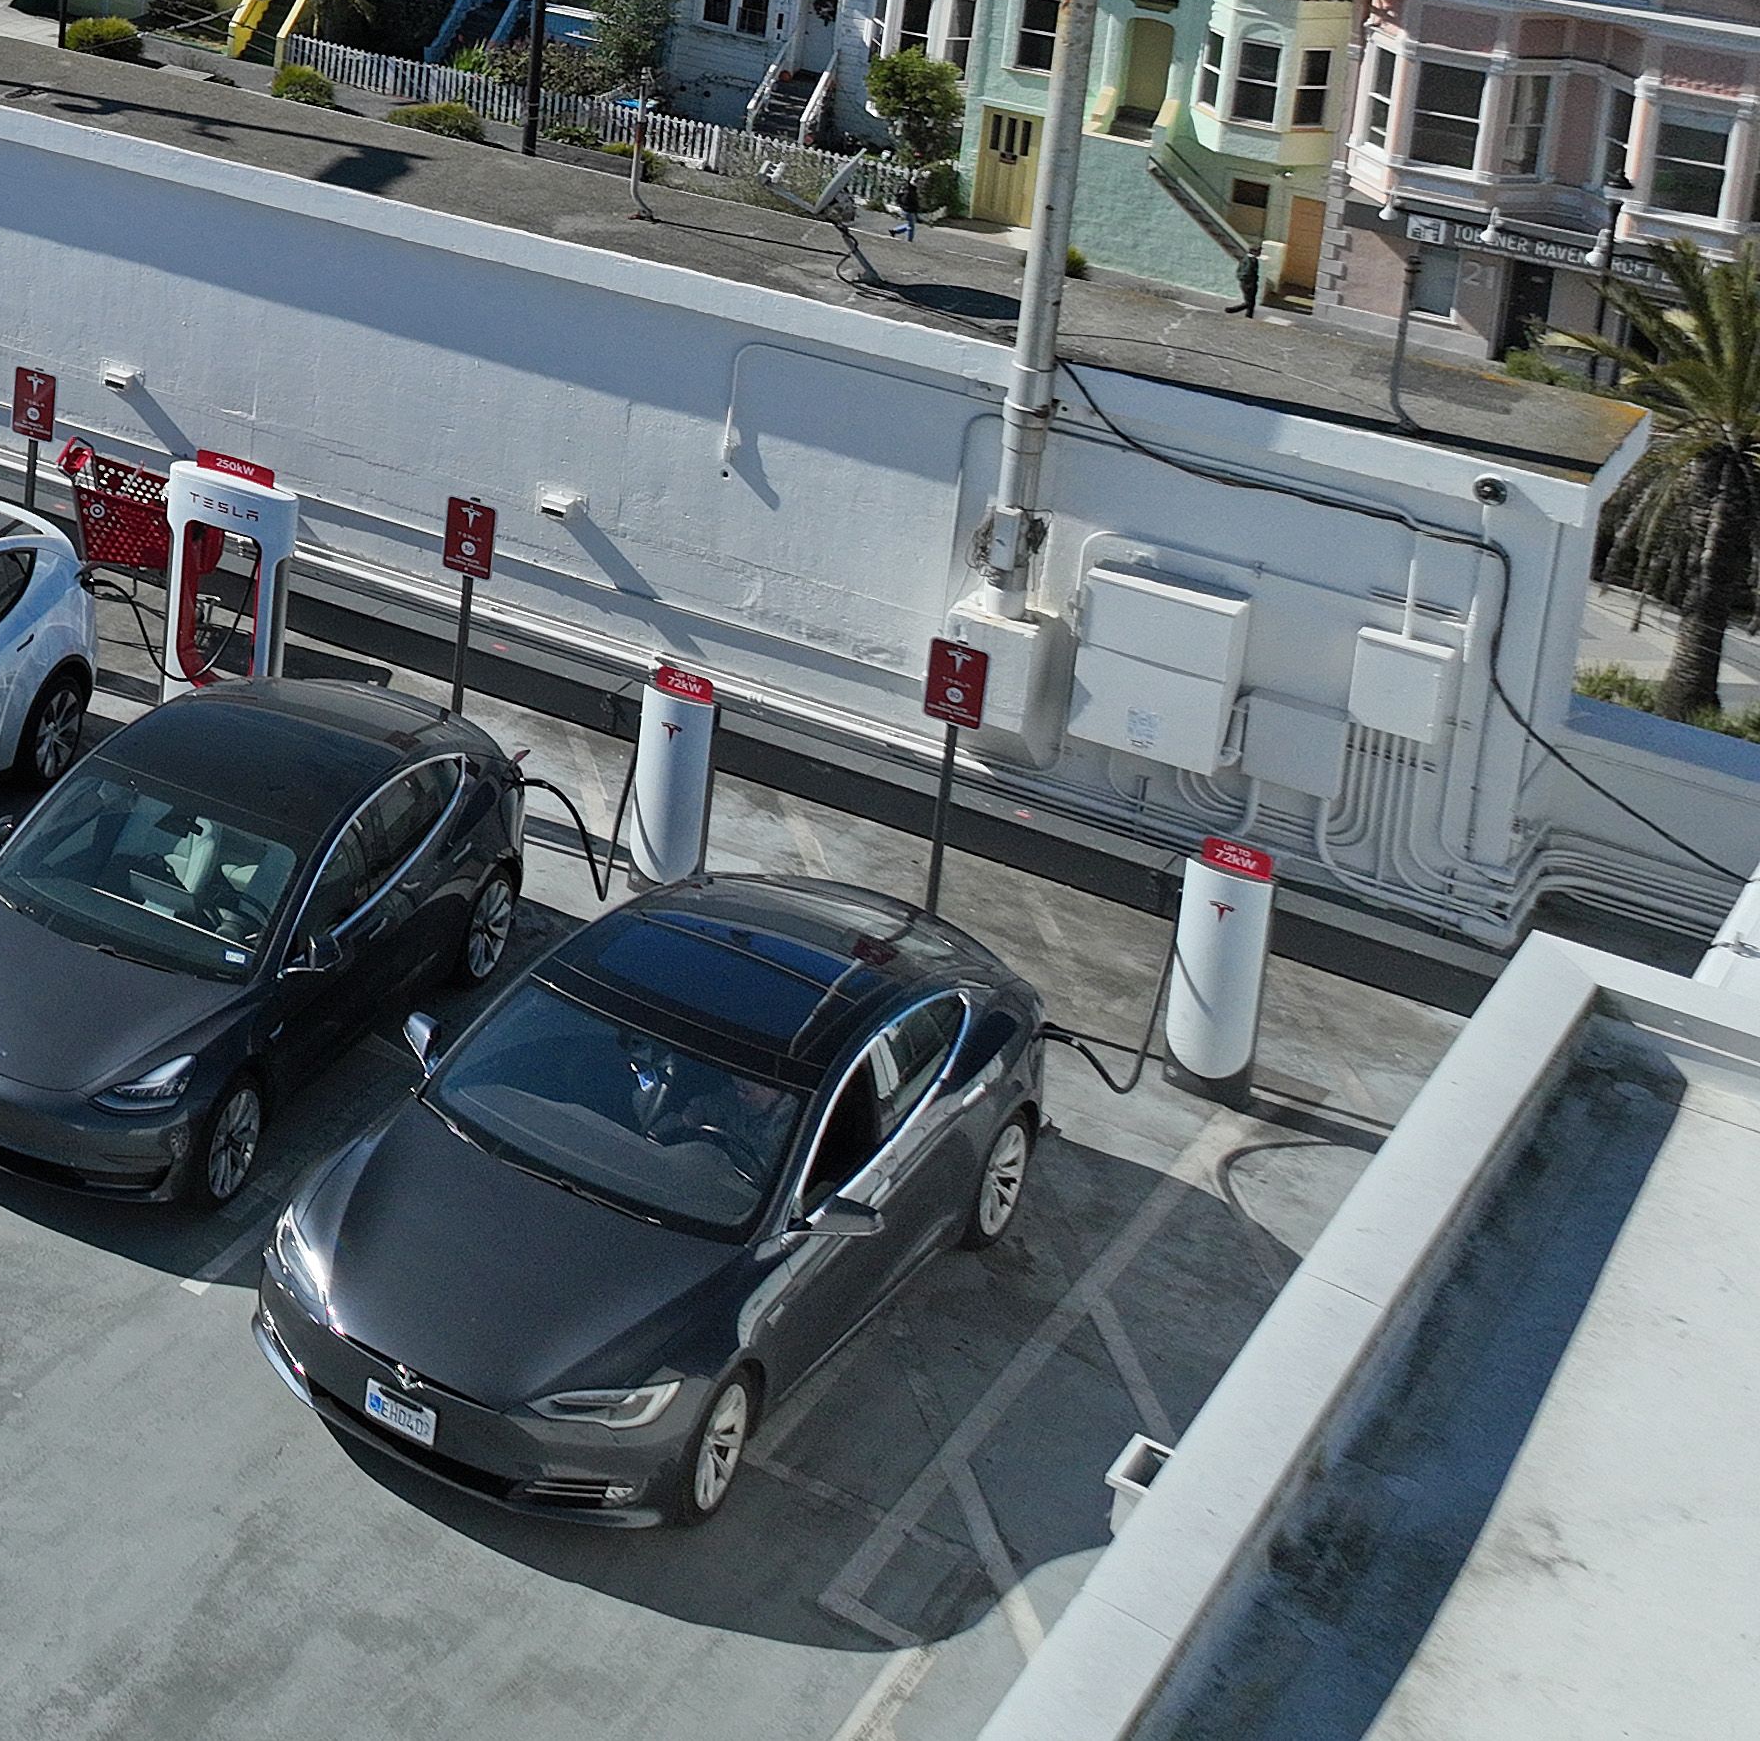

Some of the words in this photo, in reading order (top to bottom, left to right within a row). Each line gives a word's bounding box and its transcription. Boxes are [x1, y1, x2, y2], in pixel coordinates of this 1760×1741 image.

[1453, 224, 1529, 252] TOBNER
[216, 457, 256, 476] 250kW
[189, 491, 260, 522] TESLA
[667, 675, 703, 694] 72kW
[686, 674, 698, 683] TO
[1215, 848, 1259, 870] 72kW
[1223, 843, 1237, 852] UP
[1238, 848, 1253, 857] TO
